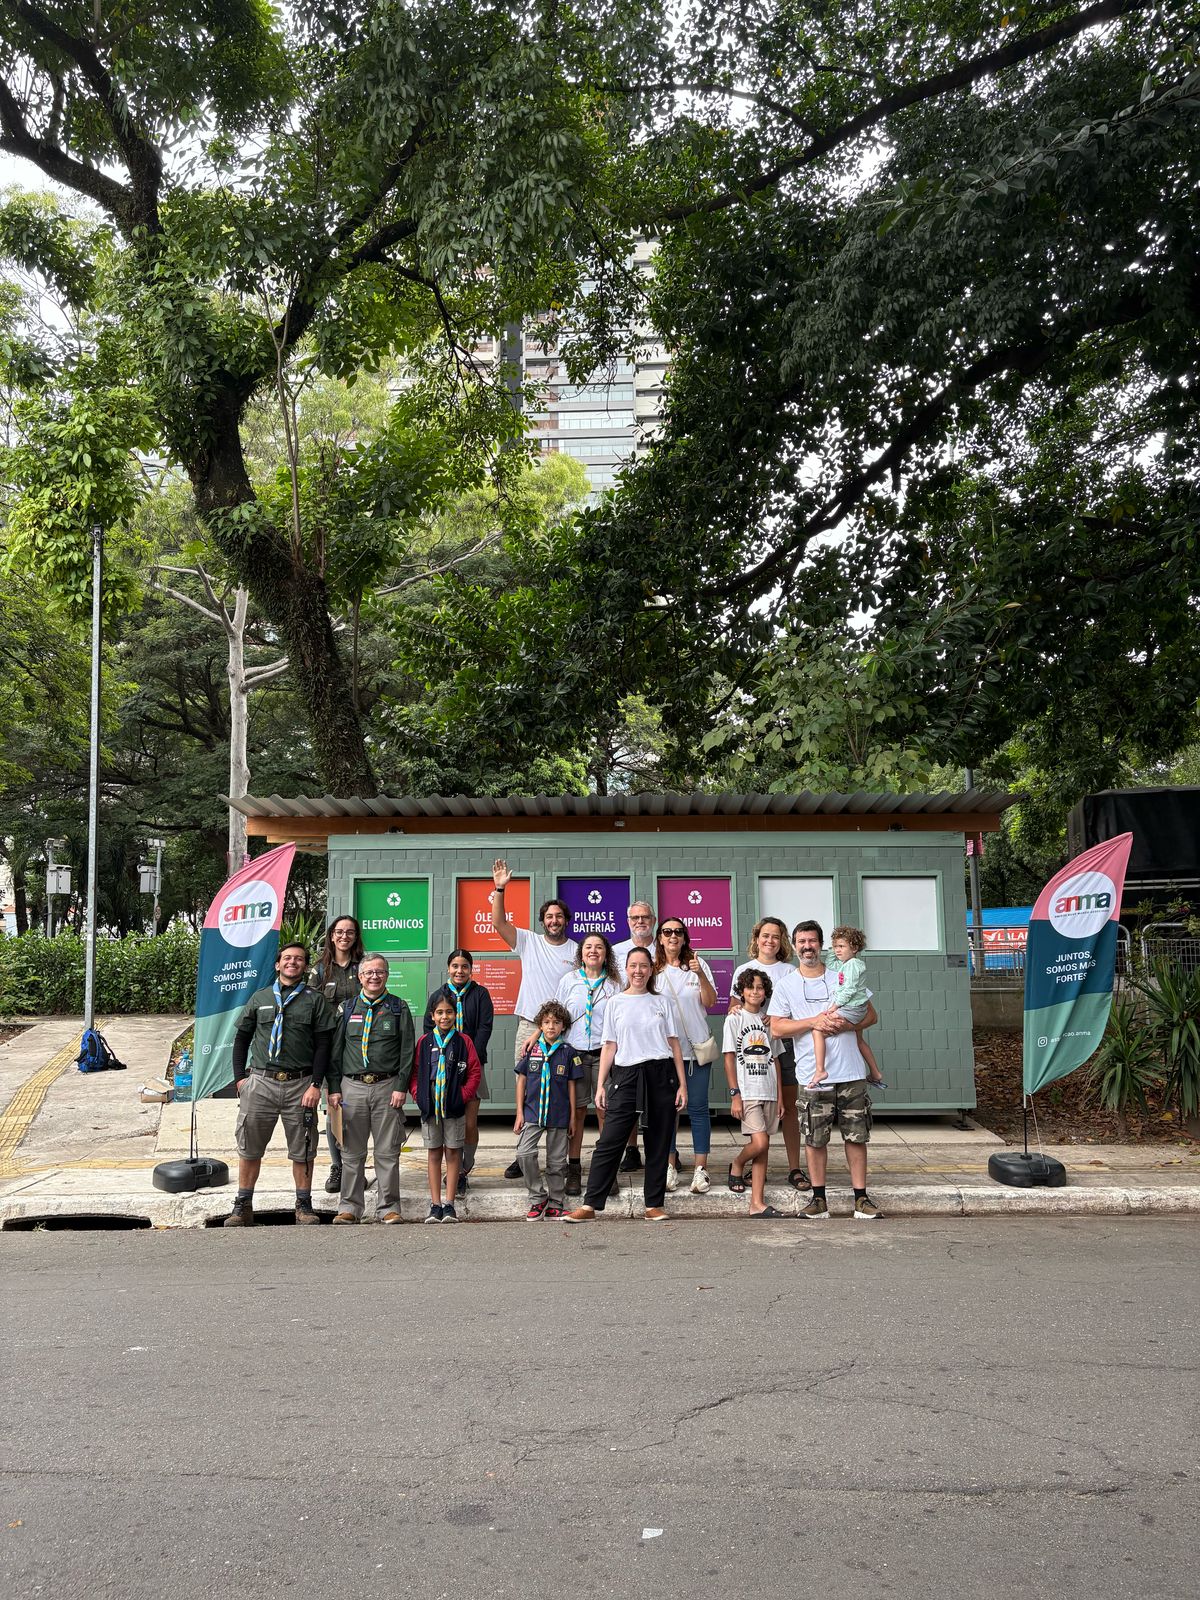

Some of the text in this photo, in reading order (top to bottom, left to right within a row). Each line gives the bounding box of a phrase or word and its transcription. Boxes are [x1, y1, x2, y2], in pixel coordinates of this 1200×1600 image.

[1055, 892, 1111, 913] anma
[223, 901, 273, 922] anma
[475, 910, 493, 922] ÓLE
[574, 911, 614, 922] PILHAS E
[362, 917, 424, 930] ELETRÔNICOS
[573, 922, 616, 933] BATERIAS
[679, 917, 723, 927] MPINHAS
[473, 923, 498, 934] COZI
[1046, 963, 1077, 975] SOMOS
[213, 971, 242, 983] SOMOS
